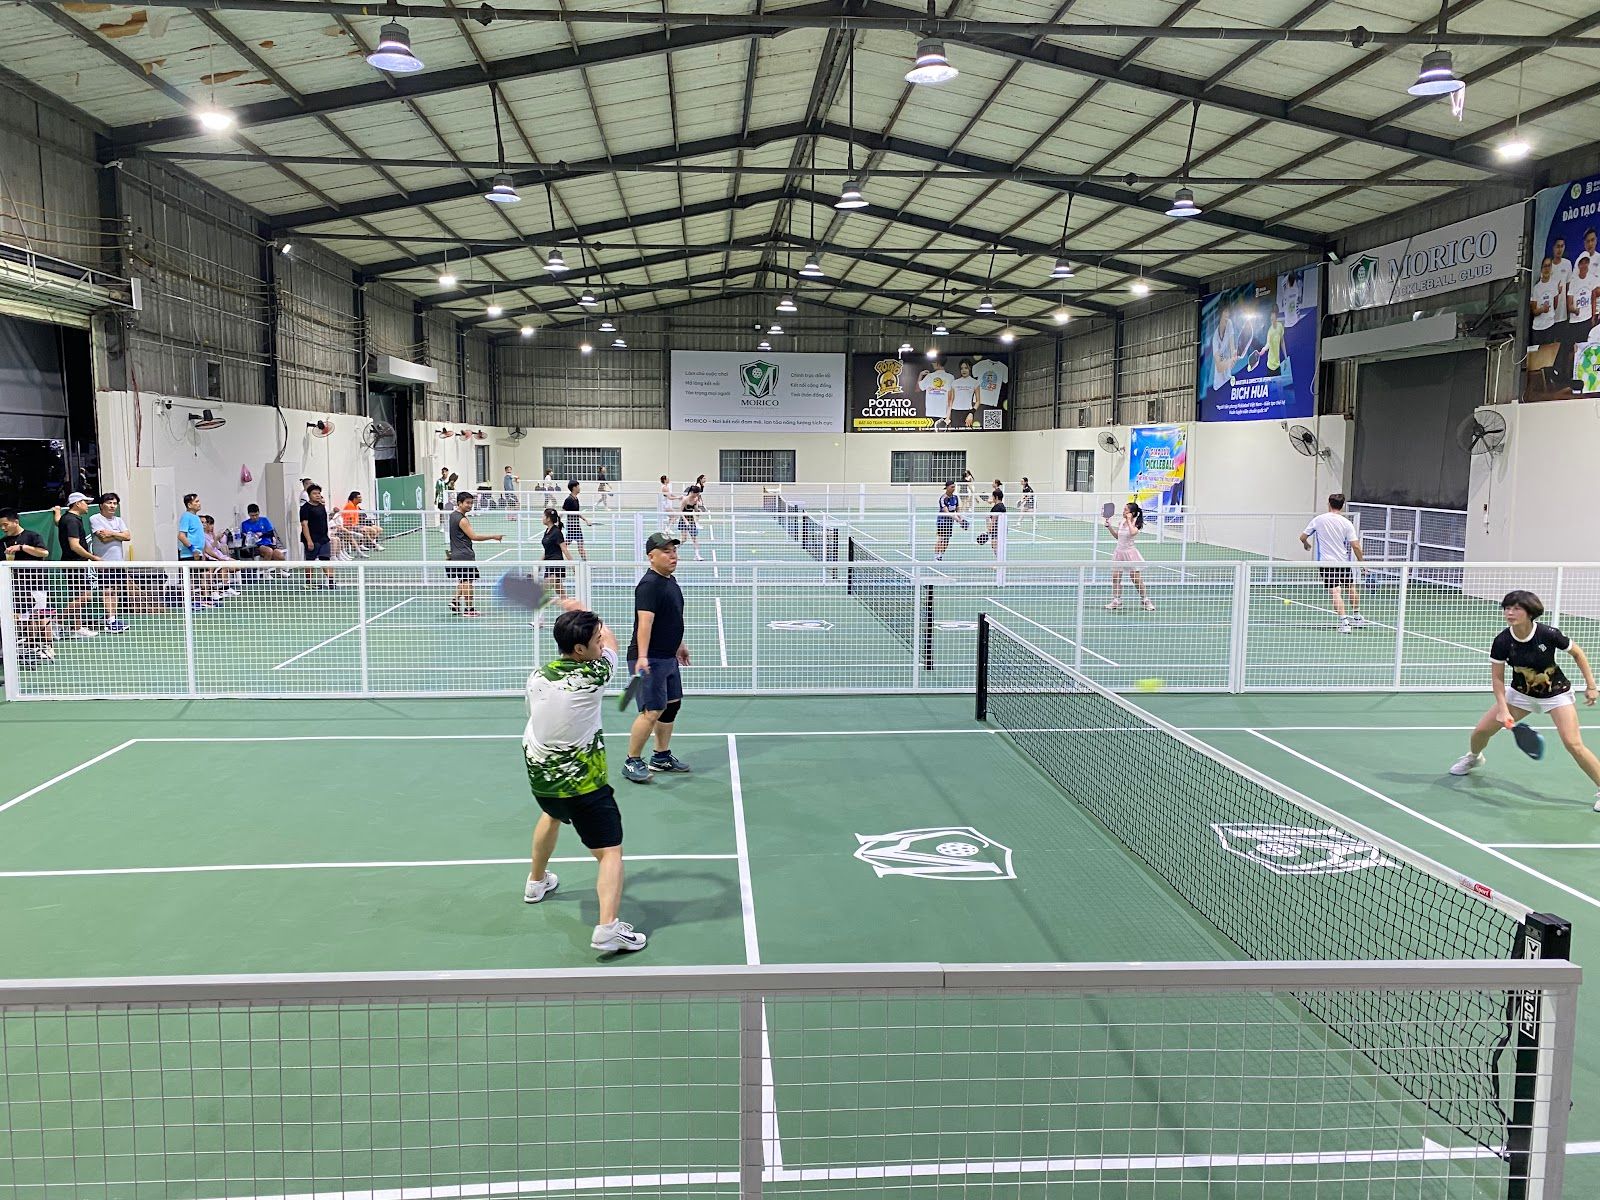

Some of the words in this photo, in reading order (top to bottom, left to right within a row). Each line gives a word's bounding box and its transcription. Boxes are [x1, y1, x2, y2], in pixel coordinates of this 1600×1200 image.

[1580, 203, 1596, 217] TẠO
[1387, 230, 1497, 283] MORICO
[1459, 264, 1493, 281] CLUB
[1230, 386, 1250, 401] BICH
[1250, 385, 1269, 399] HUA
[741, 399, 779, 407] MORICO
[868, 398, 911, 408] POTATO
[861, 407, 917, 417] CLOTHING
[1145, 459, 1175, 470] PICKLEBALL
